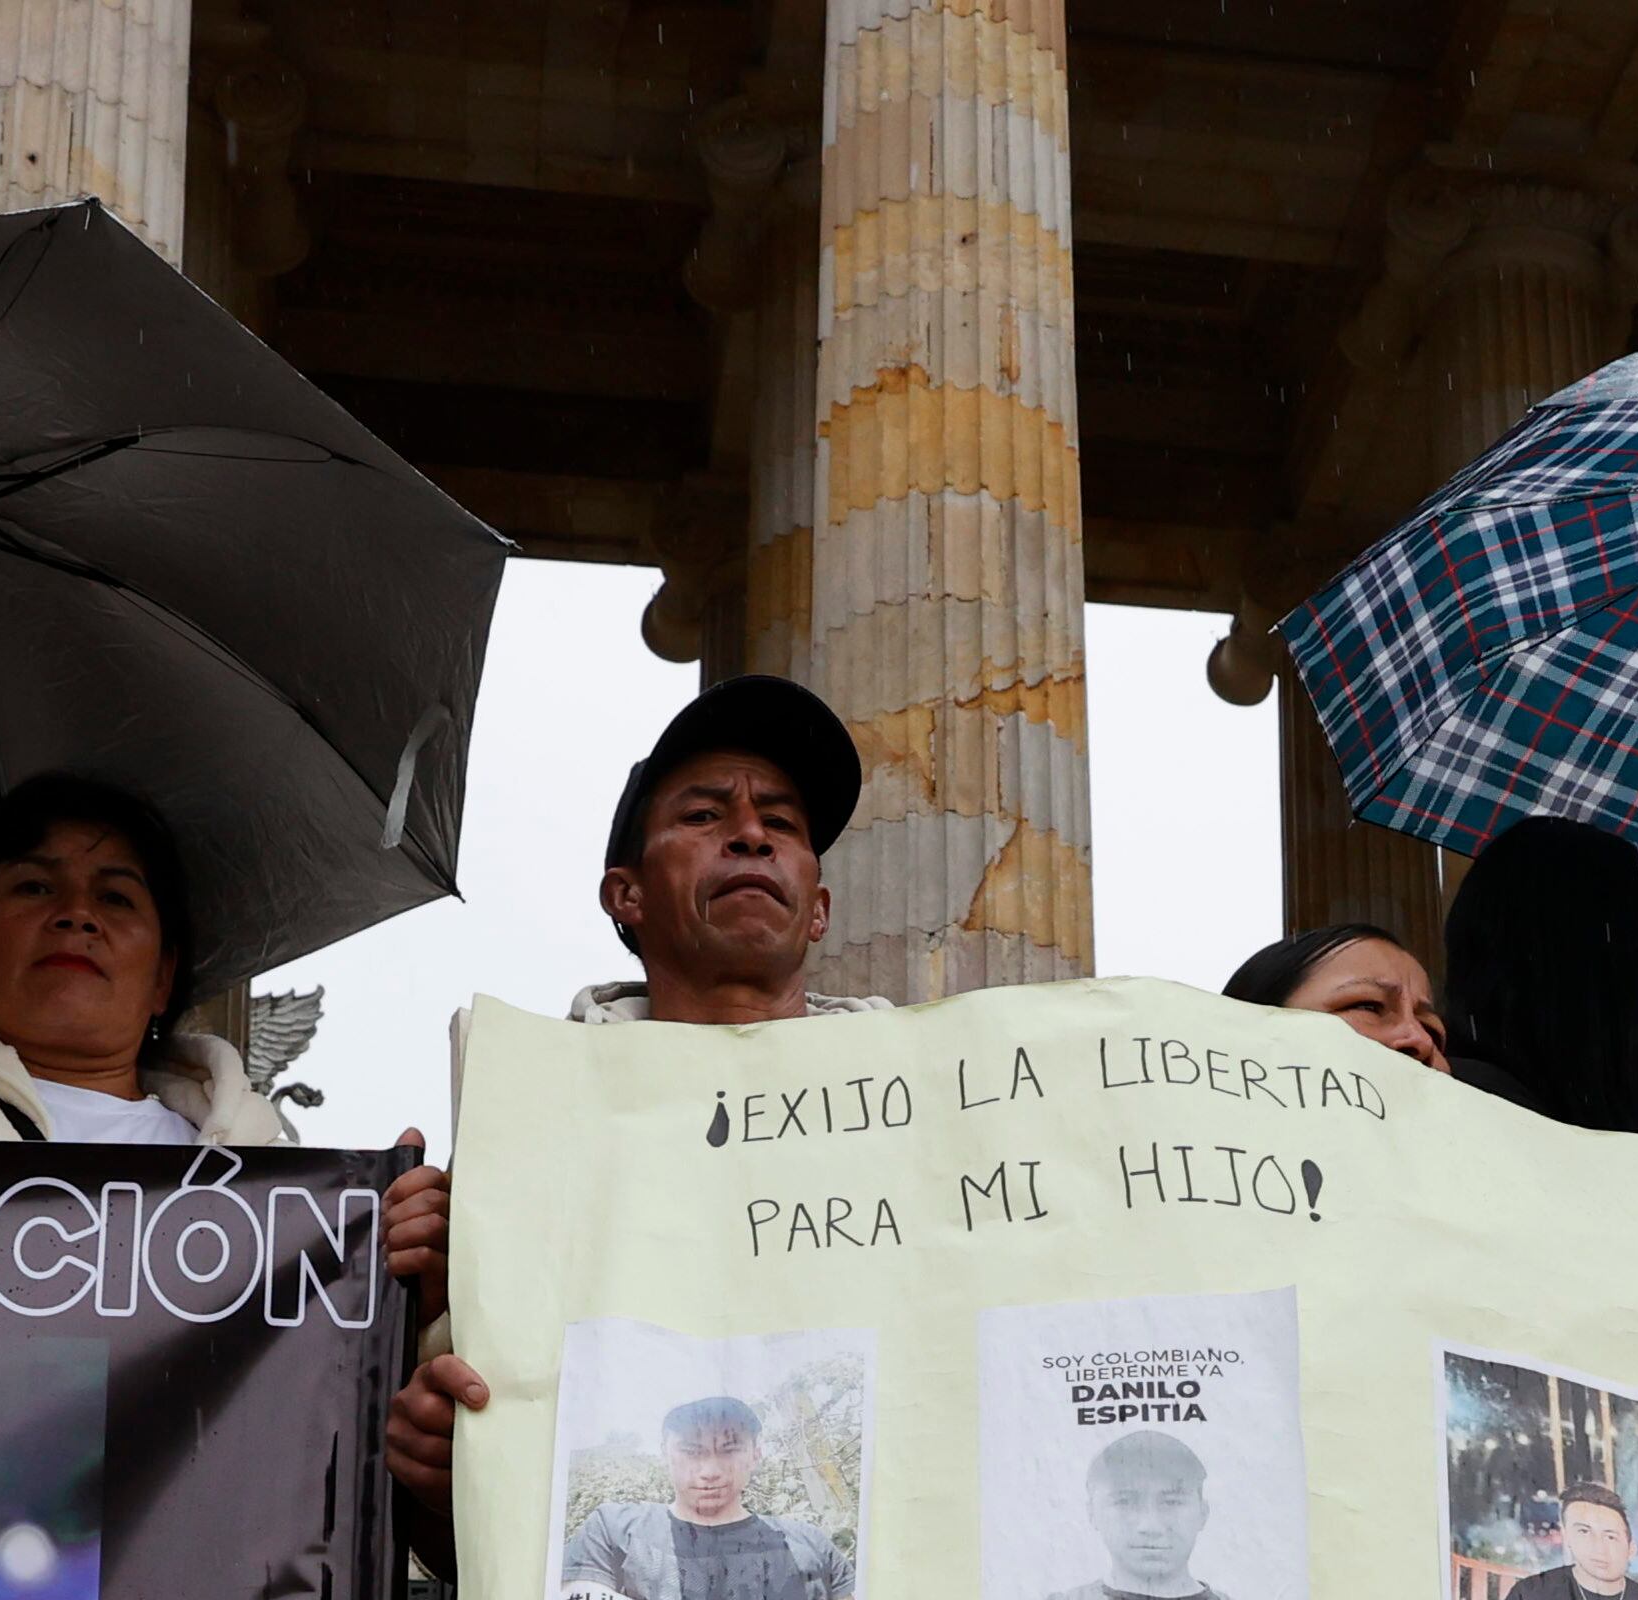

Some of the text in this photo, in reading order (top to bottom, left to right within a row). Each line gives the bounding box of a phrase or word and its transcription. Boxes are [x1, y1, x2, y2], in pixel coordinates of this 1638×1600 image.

[706, 1037, 1386, 1147] ¡EXIJO LA LIBERTAD
[746, 1142, 1324, 1257] PARA MI HIJO!
[1042, 1355, 1084, 1369] SOY
[1195, 1365, 1223, 1377] YA
[1071, 1380, 1201, 1403] DANILO
[1076, 1402, 1207, 1426] ESPITIA
